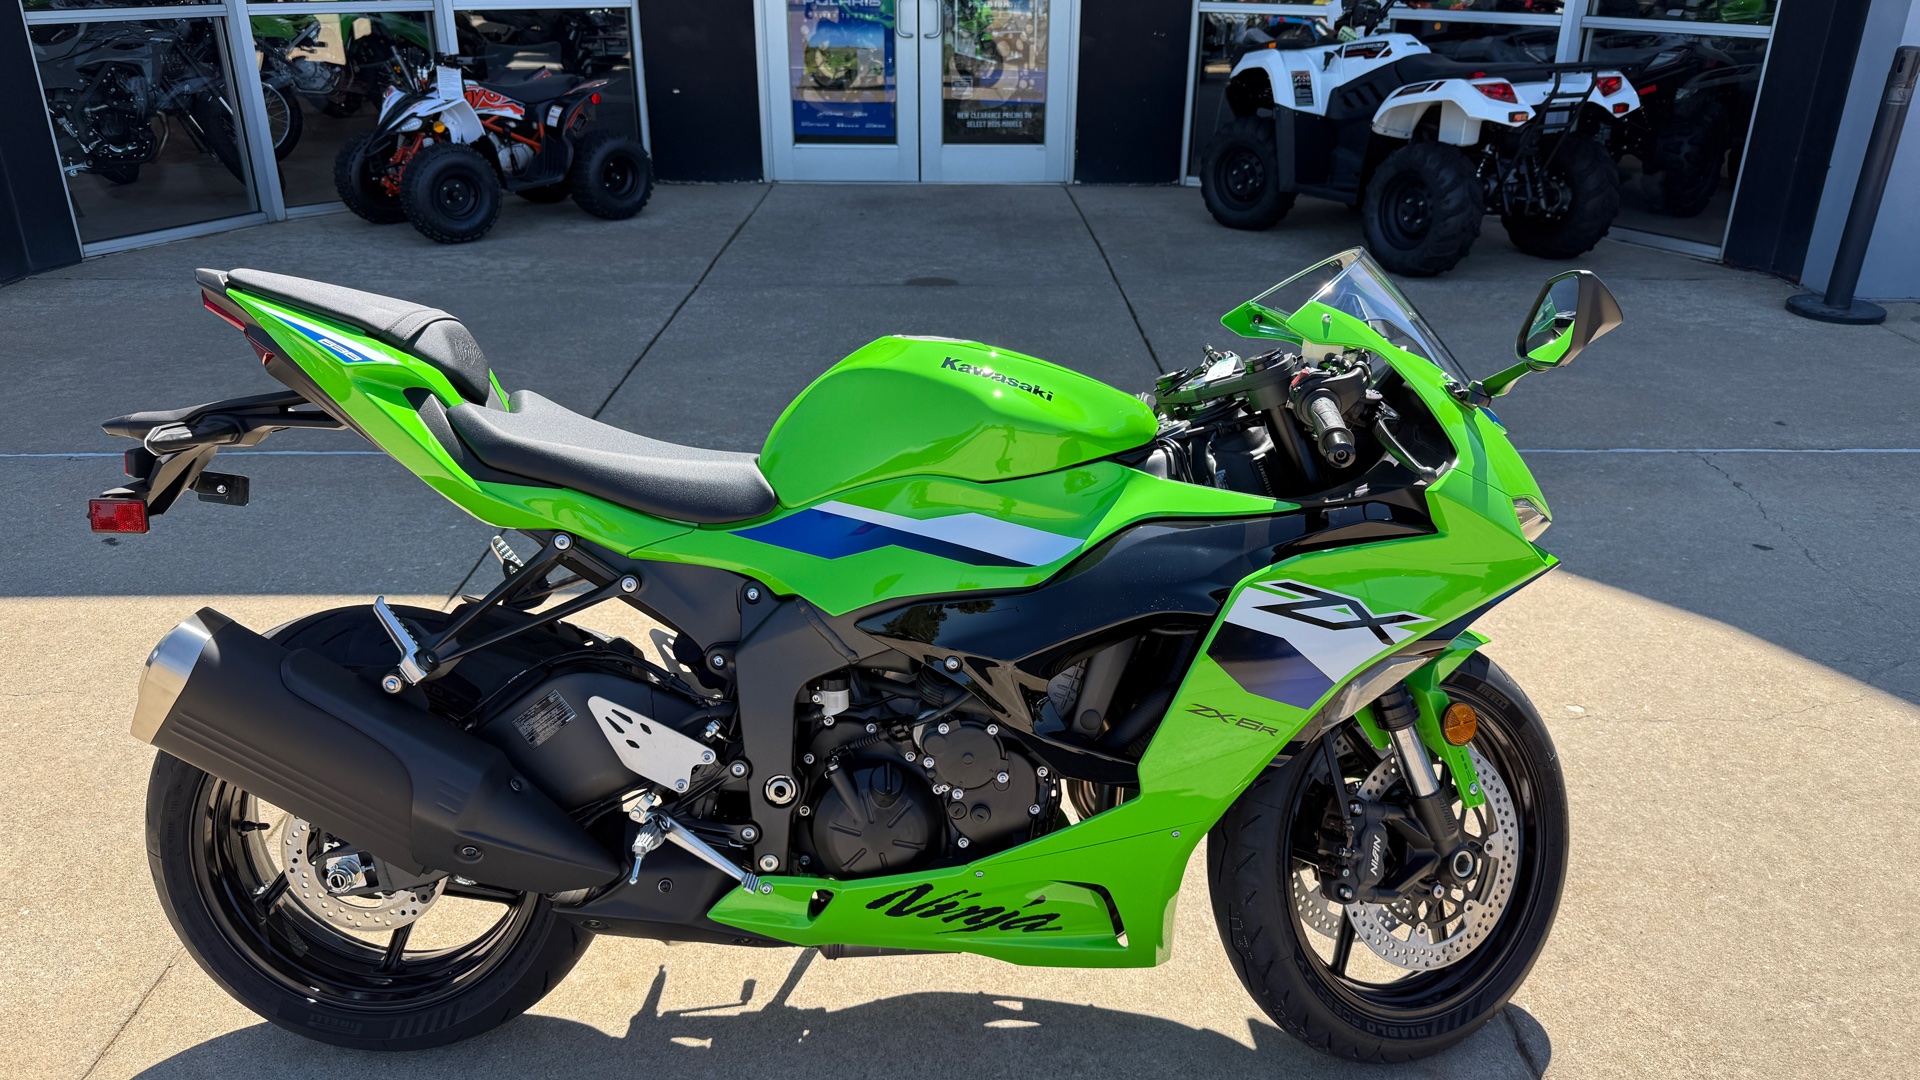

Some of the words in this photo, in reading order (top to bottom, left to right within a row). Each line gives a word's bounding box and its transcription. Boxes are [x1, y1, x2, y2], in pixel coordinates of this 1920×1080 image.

[941, 356, 1054, 402] Kawasaki
[1251, 580, 1424, 646] ZX
[1476, 683, 1511, 711] PIRELLI
[1185, 703, 1279, 737] ZX-6R
[1370, 834, 1381, 876] NISSIN
[865, 883, 1063, 934] Ninja
[1317, 986, 1361, 1027] ROSSO
[1366, 1021, 1428, 1038] DIABLO
